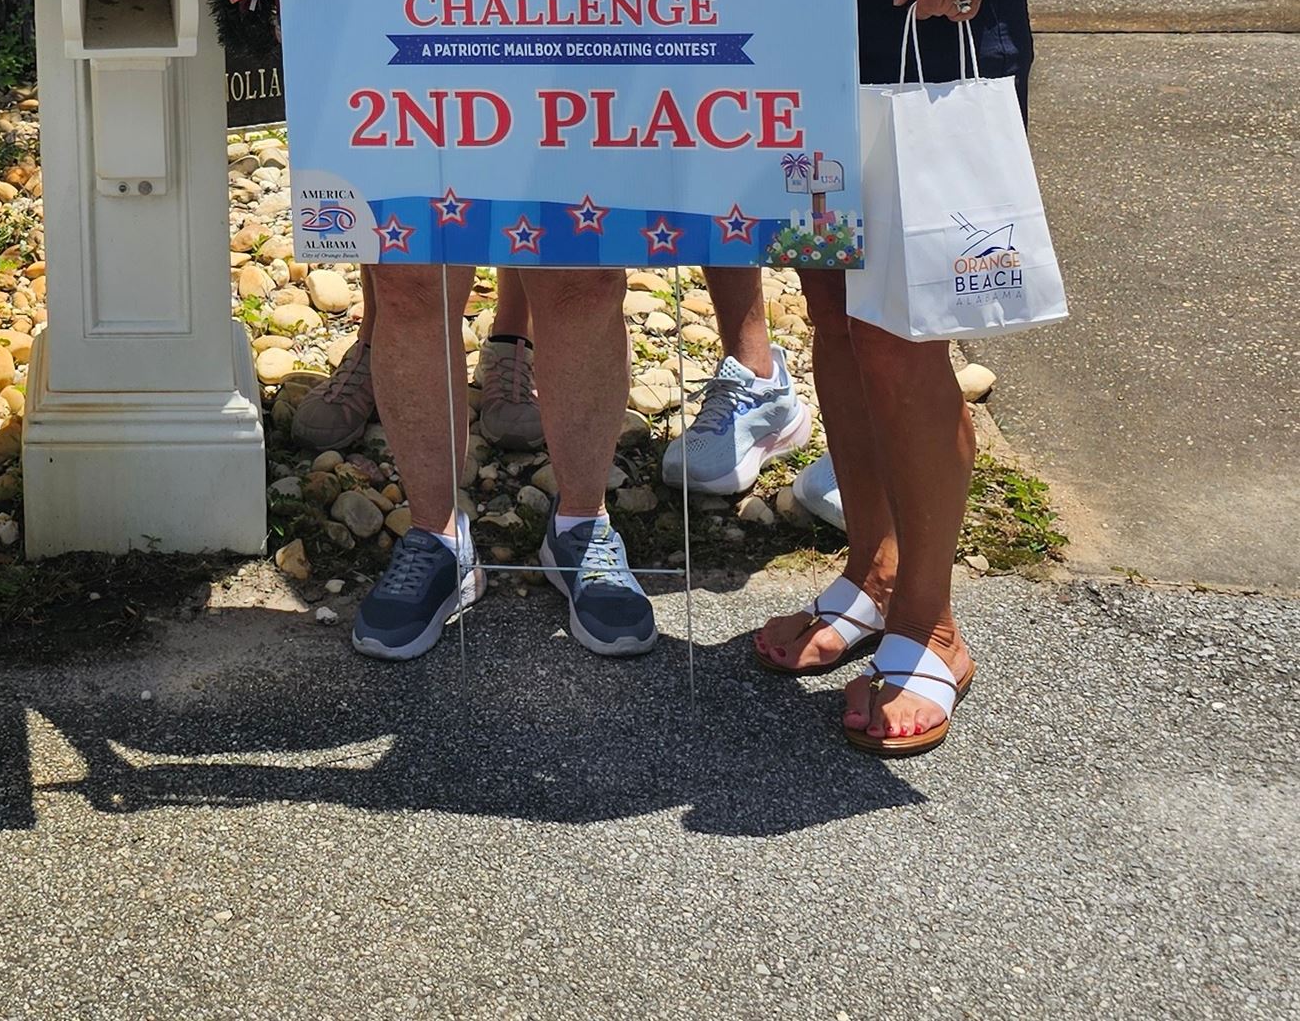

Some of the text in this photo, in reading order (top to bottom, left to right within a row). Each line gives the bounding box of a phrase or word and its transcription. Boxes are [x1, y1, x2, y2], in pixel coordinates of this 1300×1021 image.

[422, 42, 717, 57] A PATRIOTIC MAILBOX DECORATING CONTEST
[348, 88, 805, 149] 2ND PLACE
[821, 176, 841, 184] USA
[300, 190, 355, 199] AMERICA
[301, 207, 356, 232] 250
[305, 240, 357, 249] ALABAMA
[954, 252, 1021, 275] ORANGE
[955, 270, 1022, 292] BEACH
[956, 290, 1023, 306] ALABAMA
